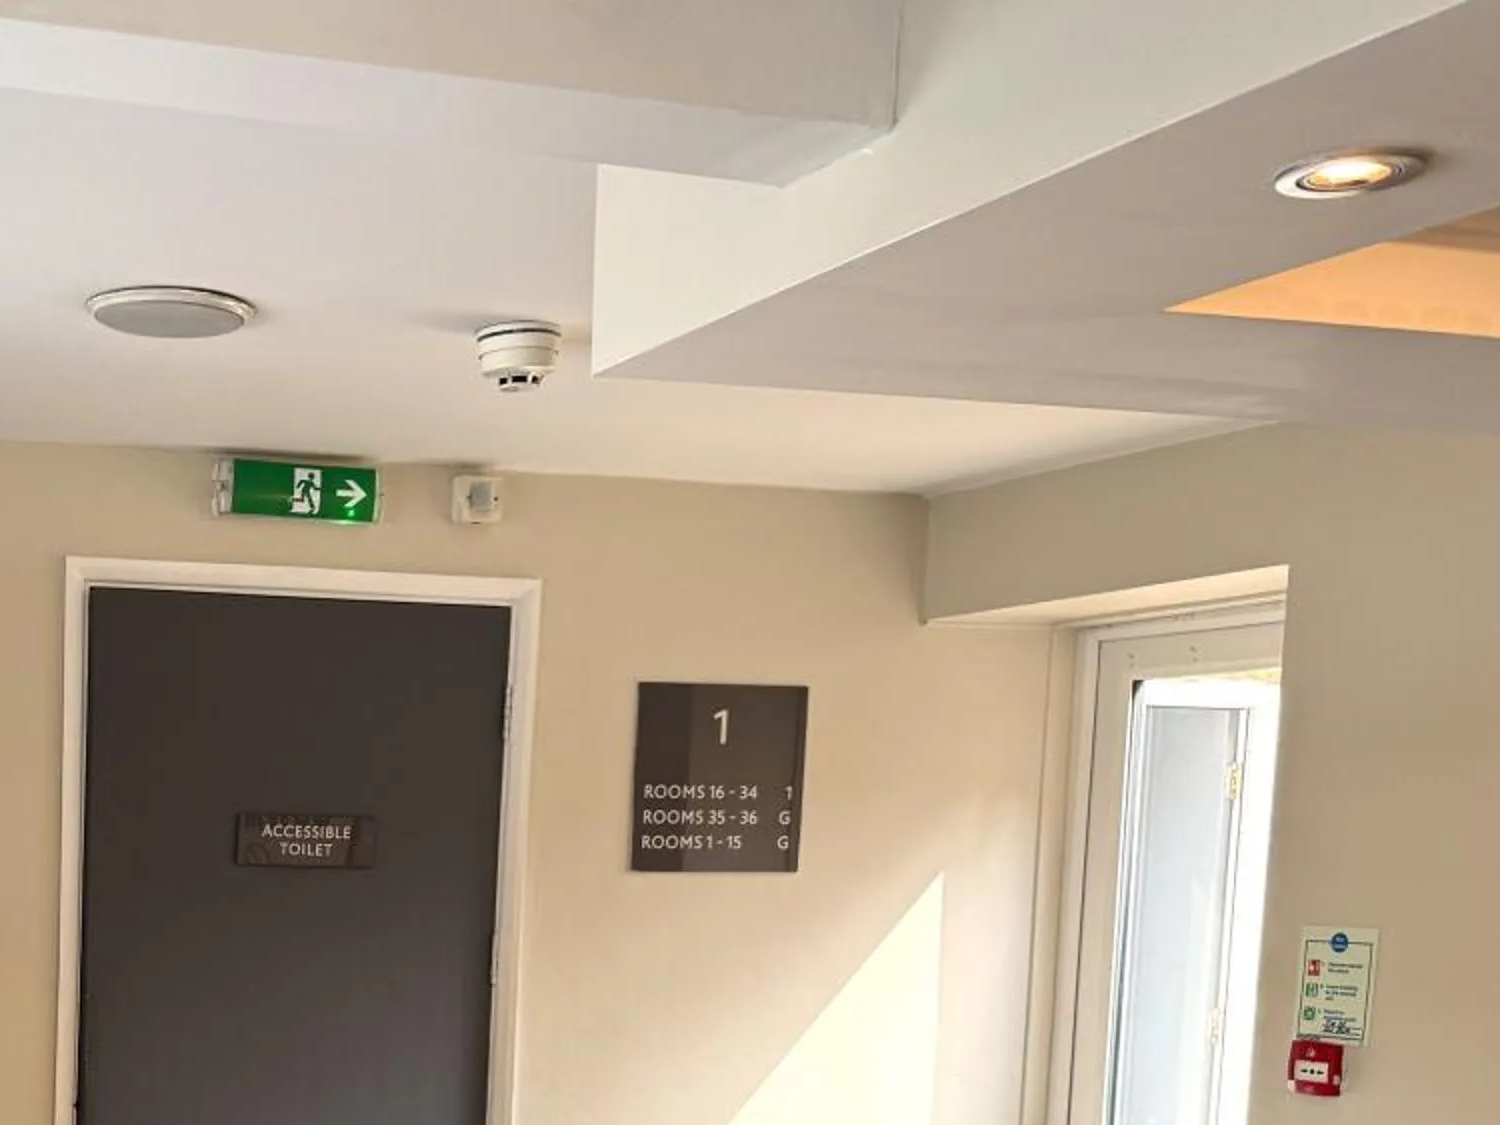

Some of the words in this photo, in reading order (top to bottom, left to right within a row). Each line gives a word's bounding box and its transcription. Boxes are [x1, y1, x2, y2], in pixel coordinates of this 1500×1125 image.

[713, 709, 730, 745] 1
[643, 784, 705, 800] ROOMS
[709, 785, 725, 800] 16
[739, 785, 758, 800] 34
[784, 786, 793, 801] 1
[642, 809, 704, 825] ROOMS
[707, 810, 725, 825] 35
[739, 810, 758, 825] 36
[778, 810, 791, 826] G
[261, 823, 352, 840] ACCESSIBLE
[279, 842, 333, 858] TOILET
[641, 835, 702, 850] ROOMS
[706, 835, 713, 850] 1
[726, 835, 742, 850] 15
[777, 835, 790, 850] G
